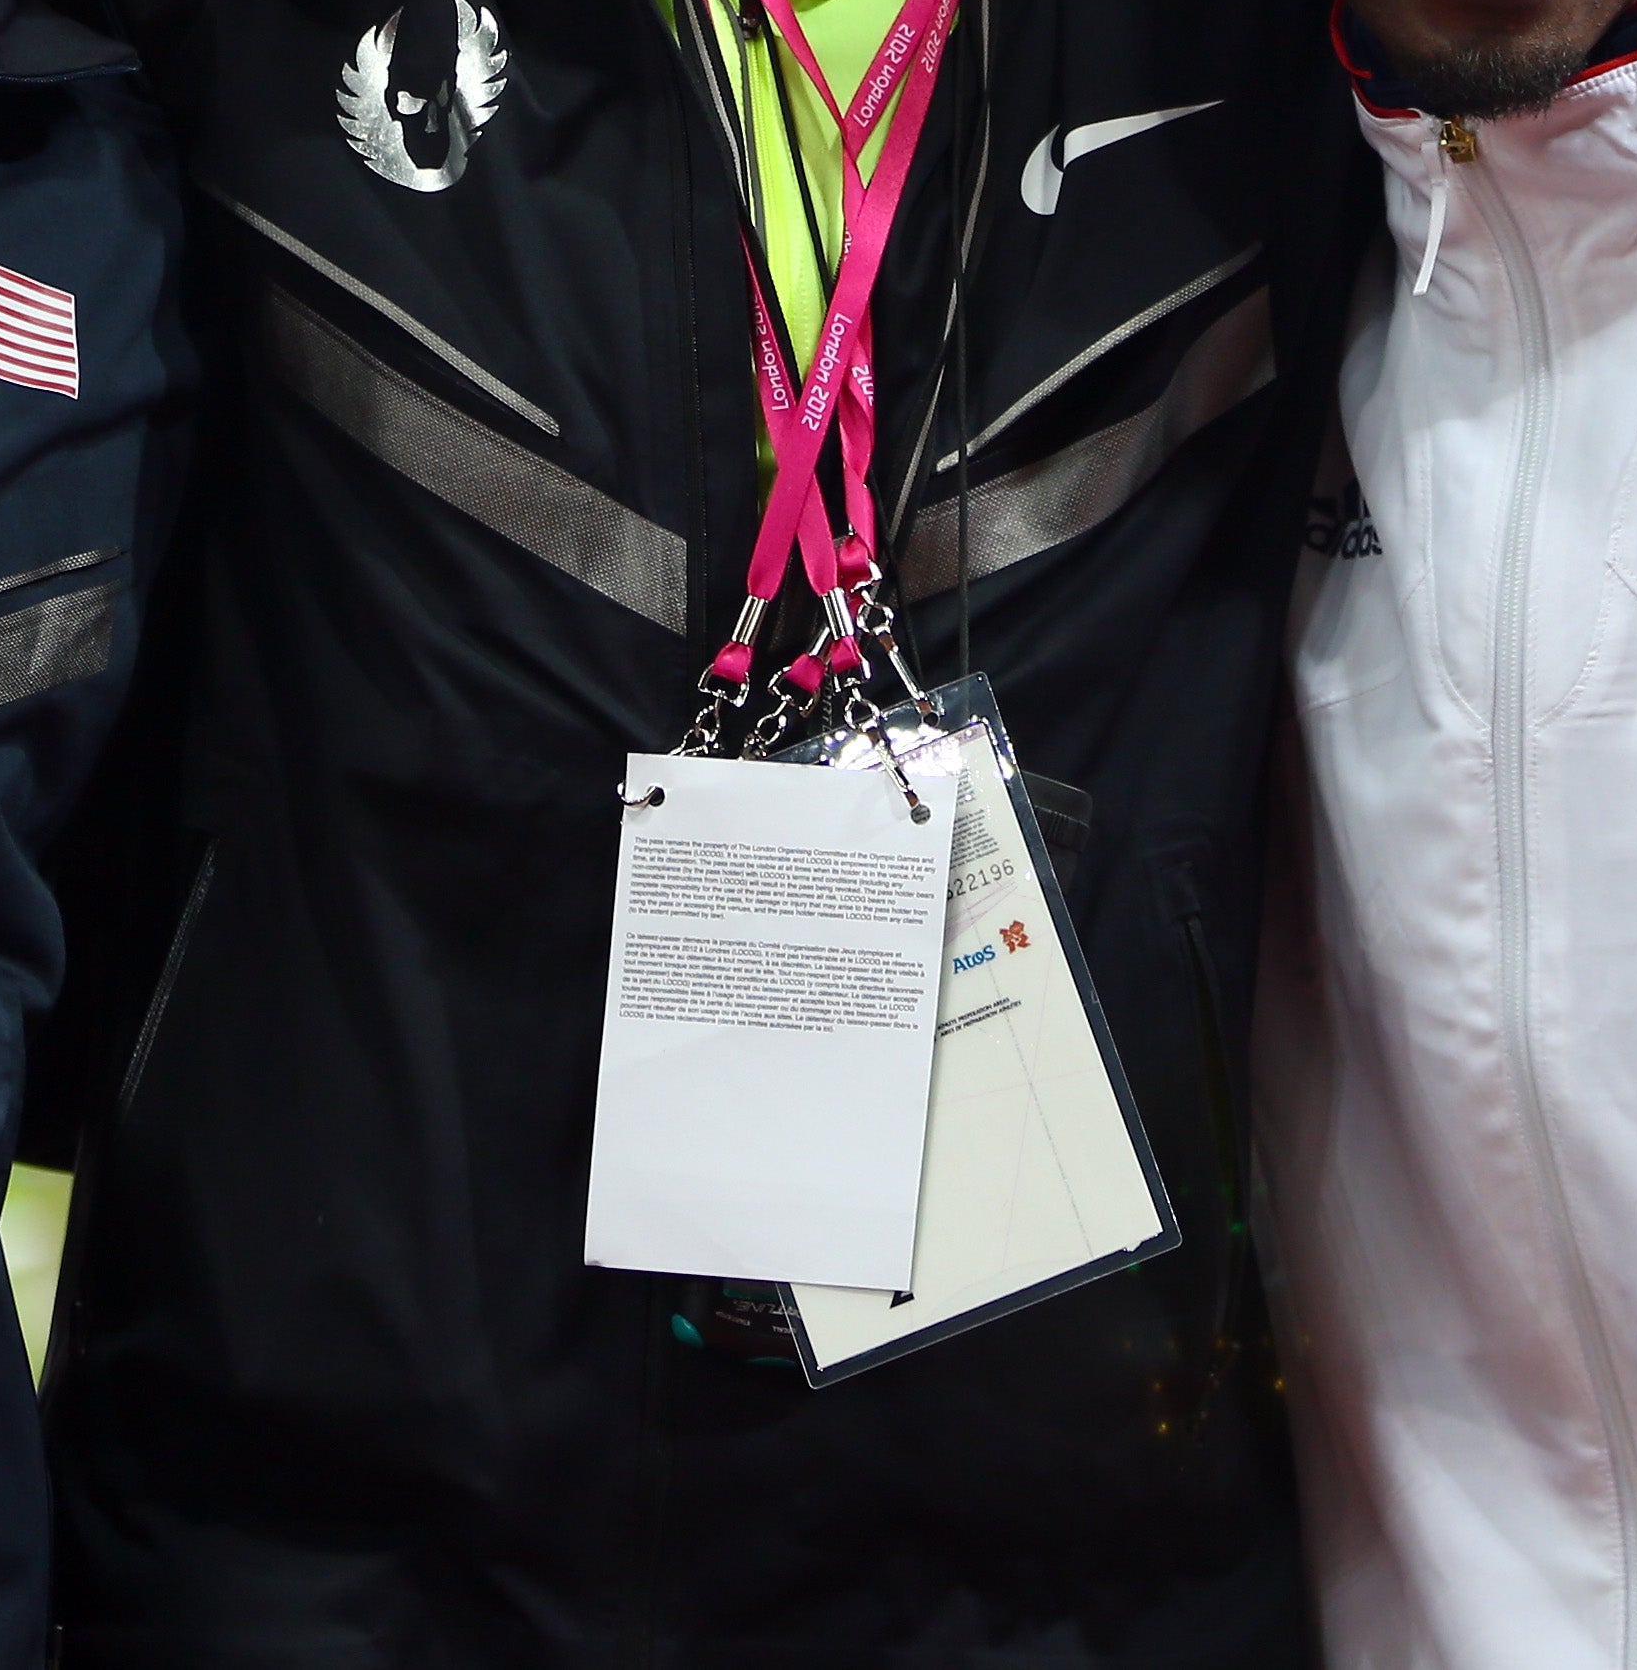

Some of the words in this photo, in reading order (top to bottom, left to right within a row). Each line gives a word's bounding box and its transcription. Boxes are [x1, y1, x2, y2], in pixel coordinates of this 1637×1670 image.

[853, 64, 896, 128] London
[884, 23, 916, 65] 2012
[921, 30, 941, 73] 2012
[761, 340, 790, 411] London
[815, 312, 853, 384] London
[801, 384, 830, 431] 2012
[953, 944, 996, 975] Atos
